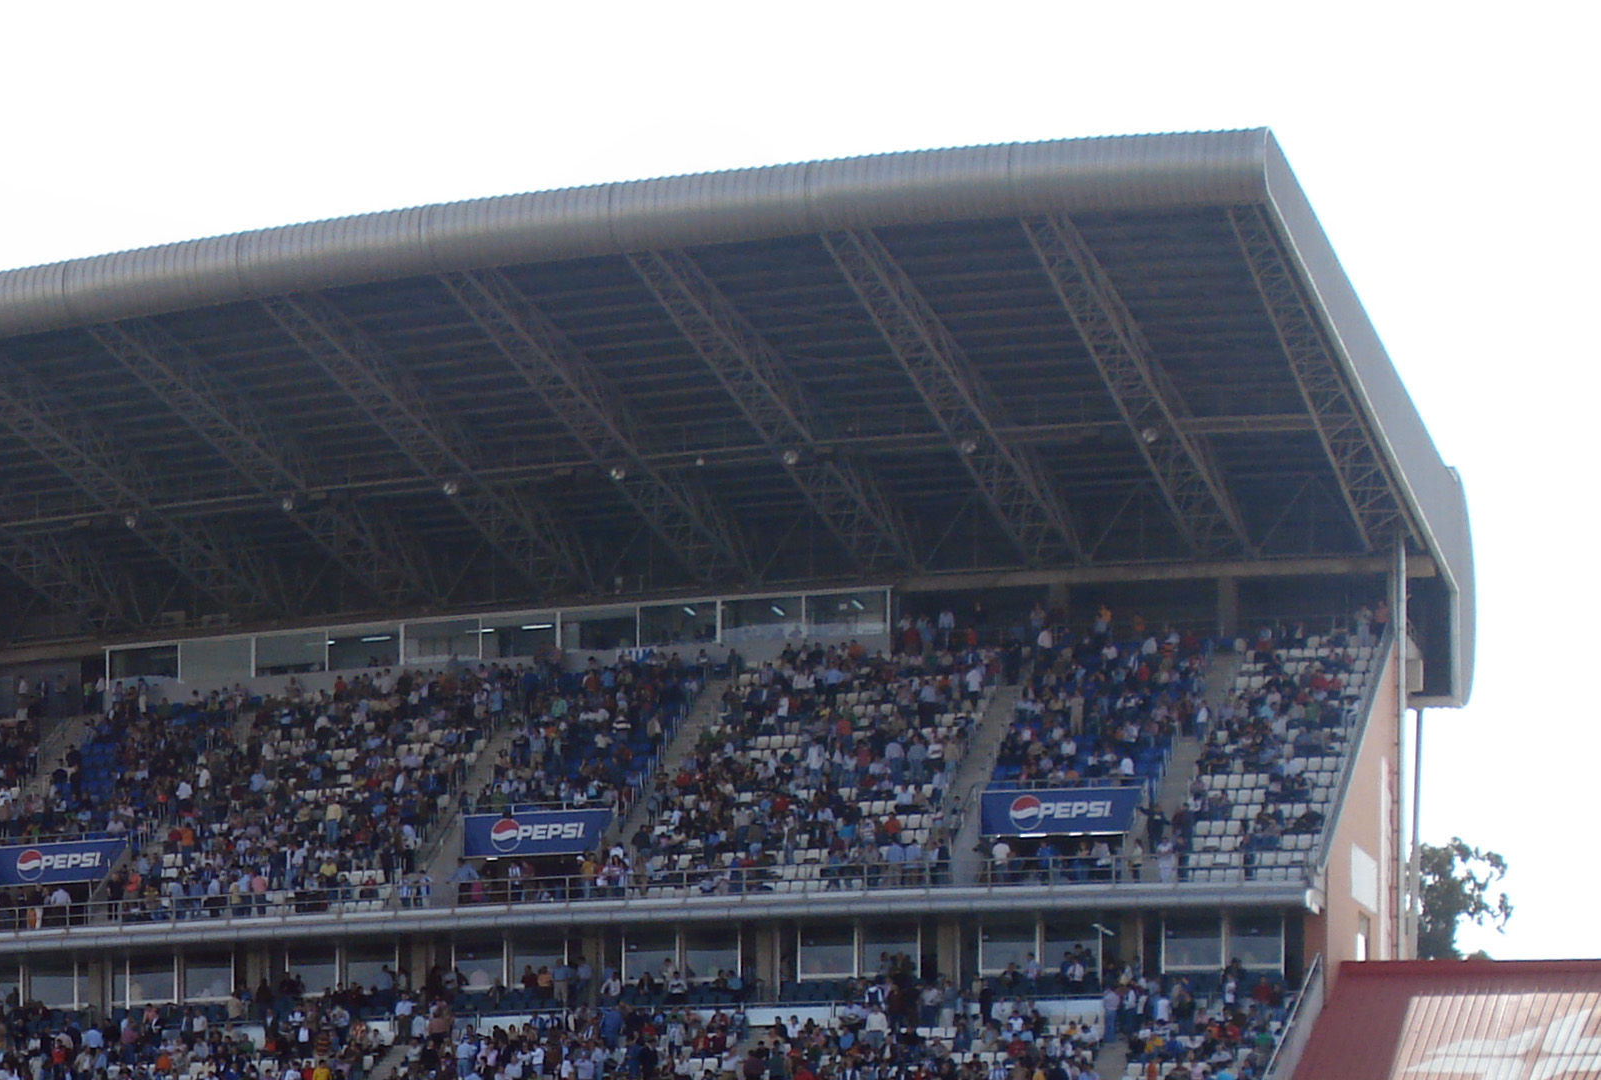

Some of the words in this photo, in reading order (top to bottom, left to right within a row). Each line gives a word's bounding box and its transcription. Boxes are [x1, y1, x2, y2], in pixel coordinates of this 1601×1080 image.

[1037, 801, 1112, 821] PEPSI
[514, 822, 585, 841] PEPSI
[39, 851, 102, 870] PEPSI
